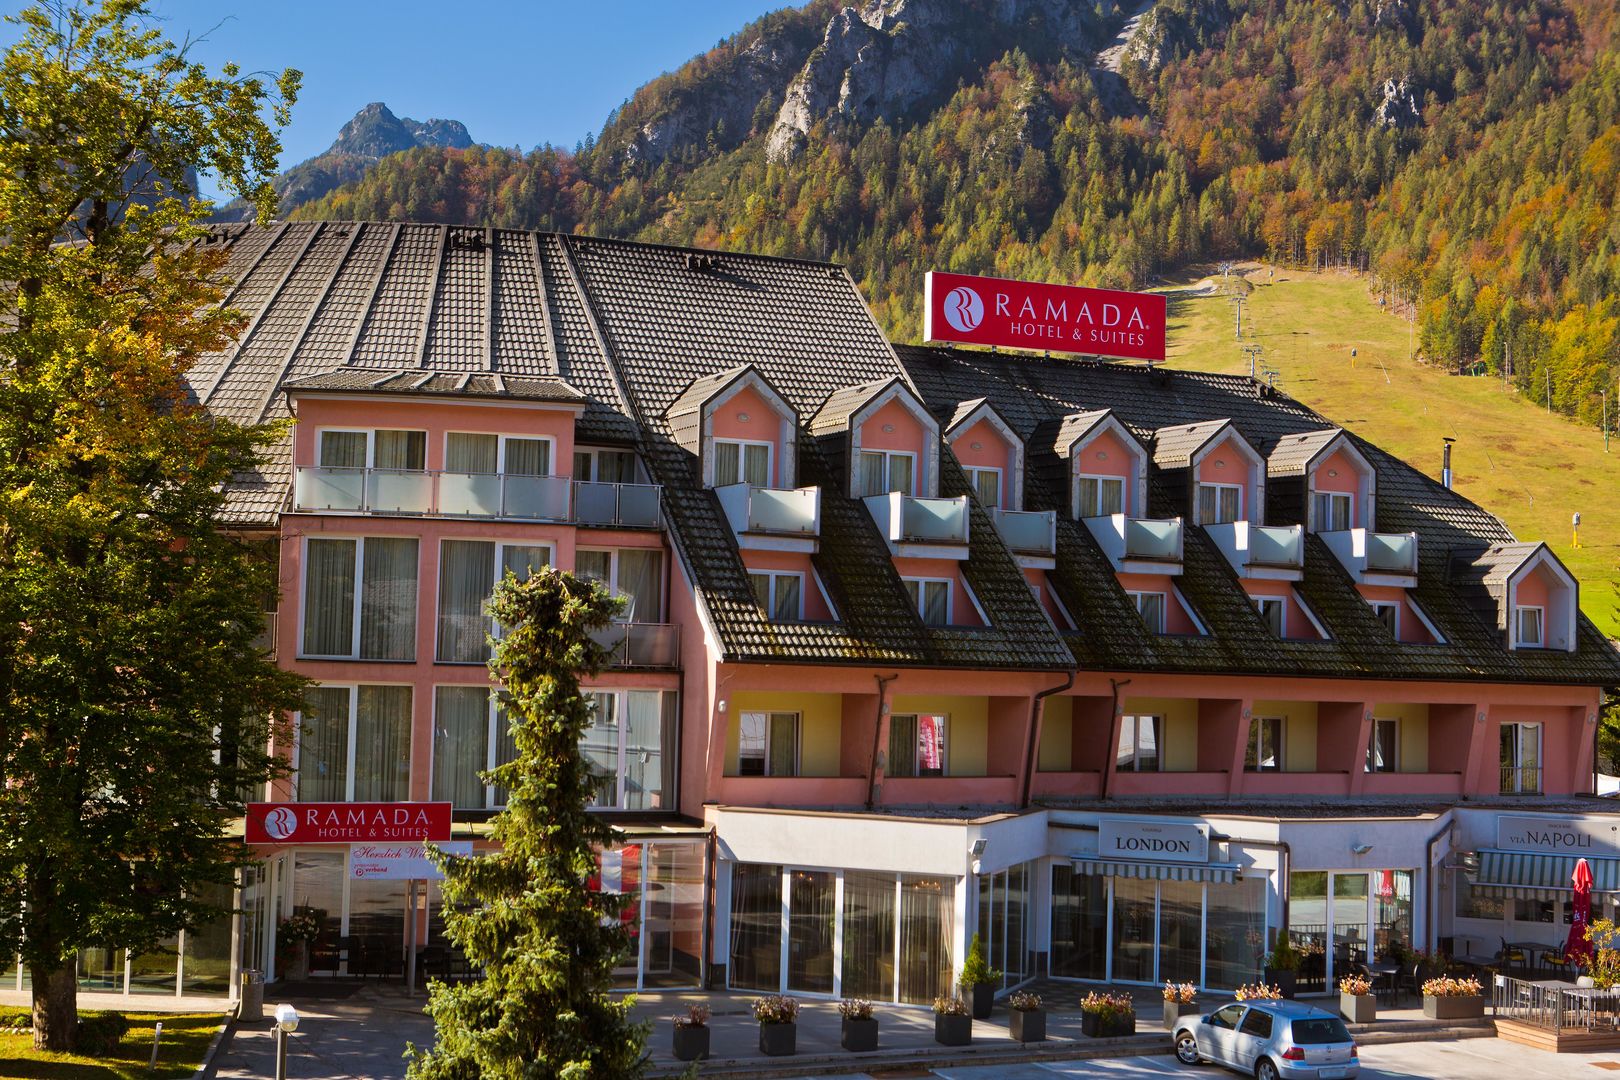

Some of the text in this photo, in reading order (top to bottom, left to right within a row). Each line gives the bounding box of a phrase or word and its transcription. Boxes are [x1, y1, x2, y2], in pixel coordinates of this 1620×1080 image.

[996, 293, 1144, 330] RAMADA
[1011, 322, 1145, 346] HOTEL & SUITES
[306, 809, 430, 826] RAMADA
[318, 827, 429, 838] HOTEL & SUITES
[1527, 831, 1592, 848] NAPOLI
[353, 846, 403, 859] Herzlich
[1116, 837, 1191, 853] LONDON
